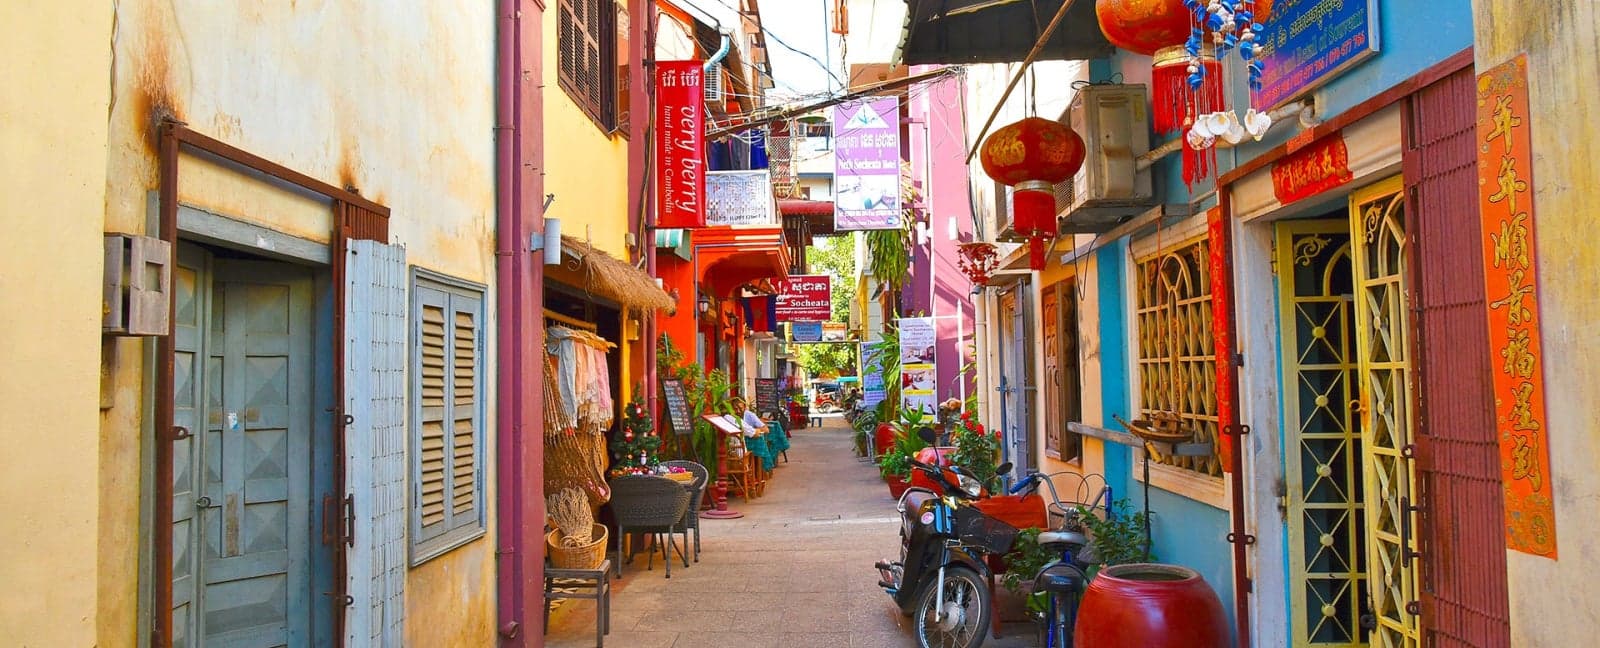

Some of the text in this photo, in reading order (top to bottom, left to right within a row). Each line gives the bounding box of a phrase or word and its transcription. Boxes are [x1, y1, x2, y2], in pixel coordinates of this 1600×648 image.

[664, 105, 674, 214] hand made in Cambodia
[674, 105, 702, 213] very berry
[790, 299, 829, 307] Socheata
